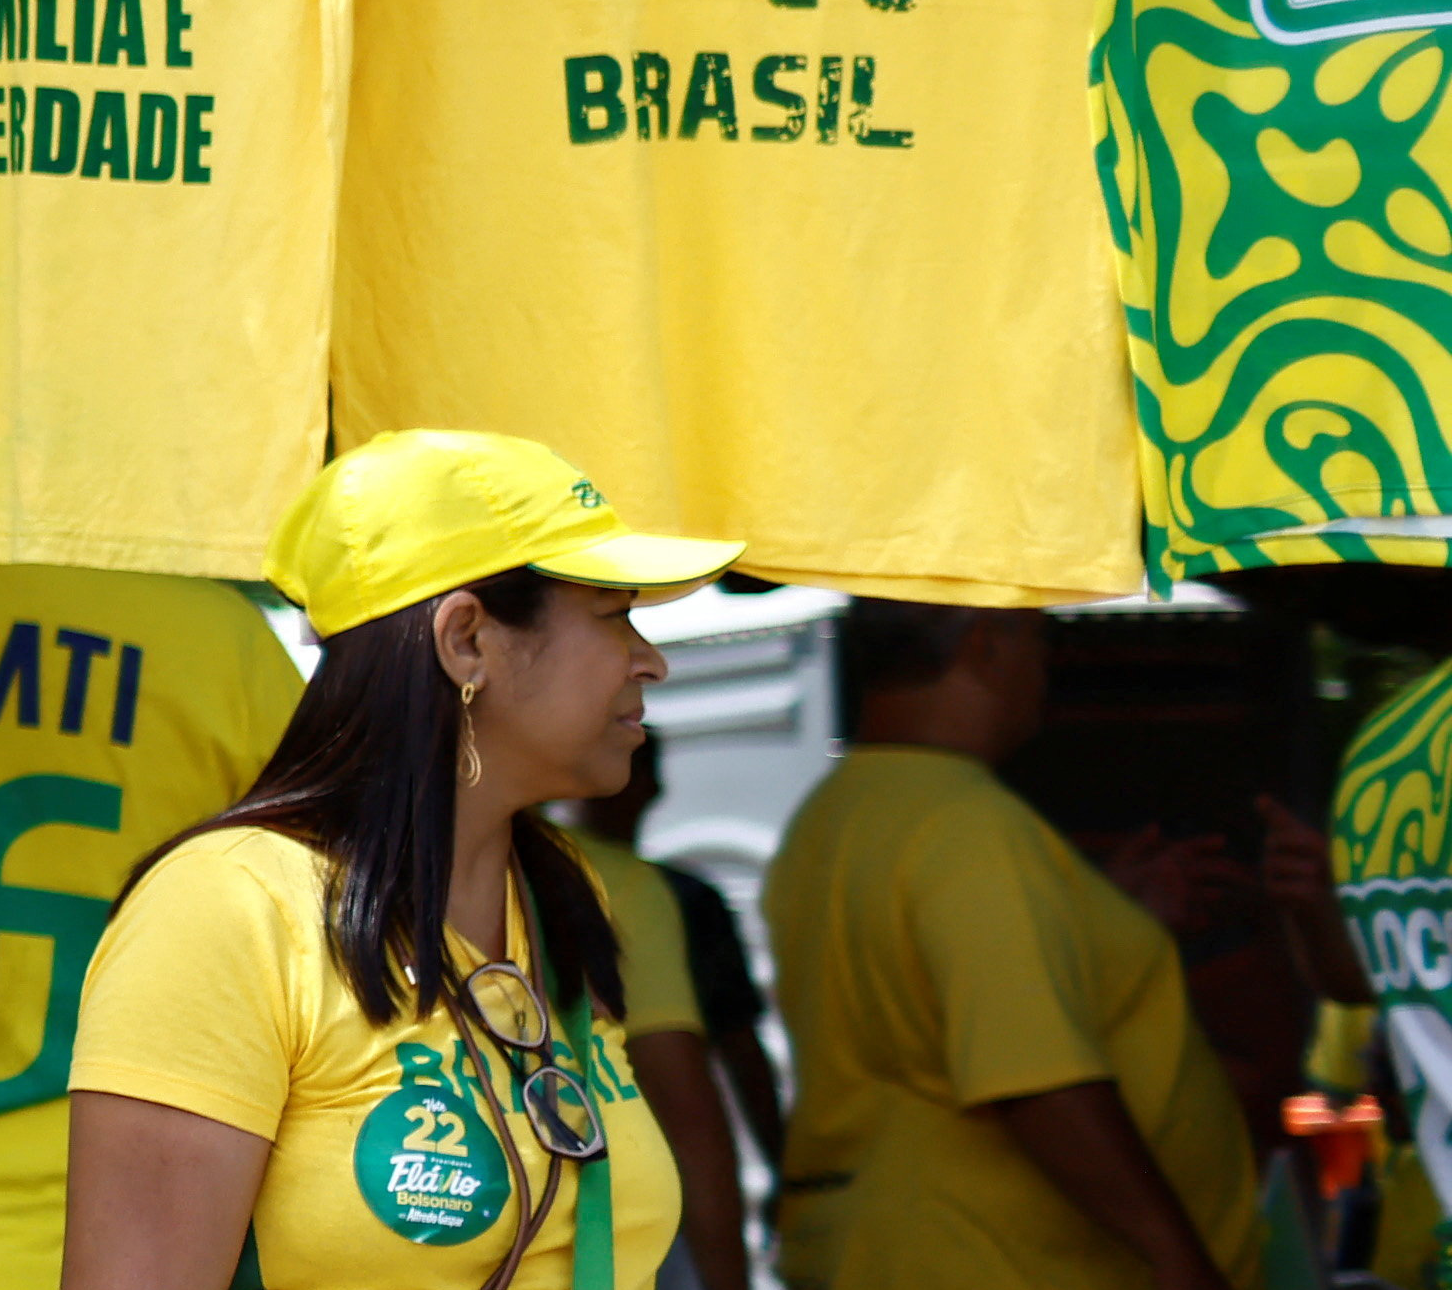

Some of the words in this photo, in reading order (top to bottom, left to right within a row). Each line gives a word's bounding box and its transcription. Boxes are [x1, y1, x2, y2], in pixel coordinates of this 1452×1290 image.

[564, 50, 914, 148] BRASIL
[403, 1106, 469, 1157] 22
[387, 1153, 481, 1196] Flávio
[396, 1191, 473, 1212] Bolsonaro
